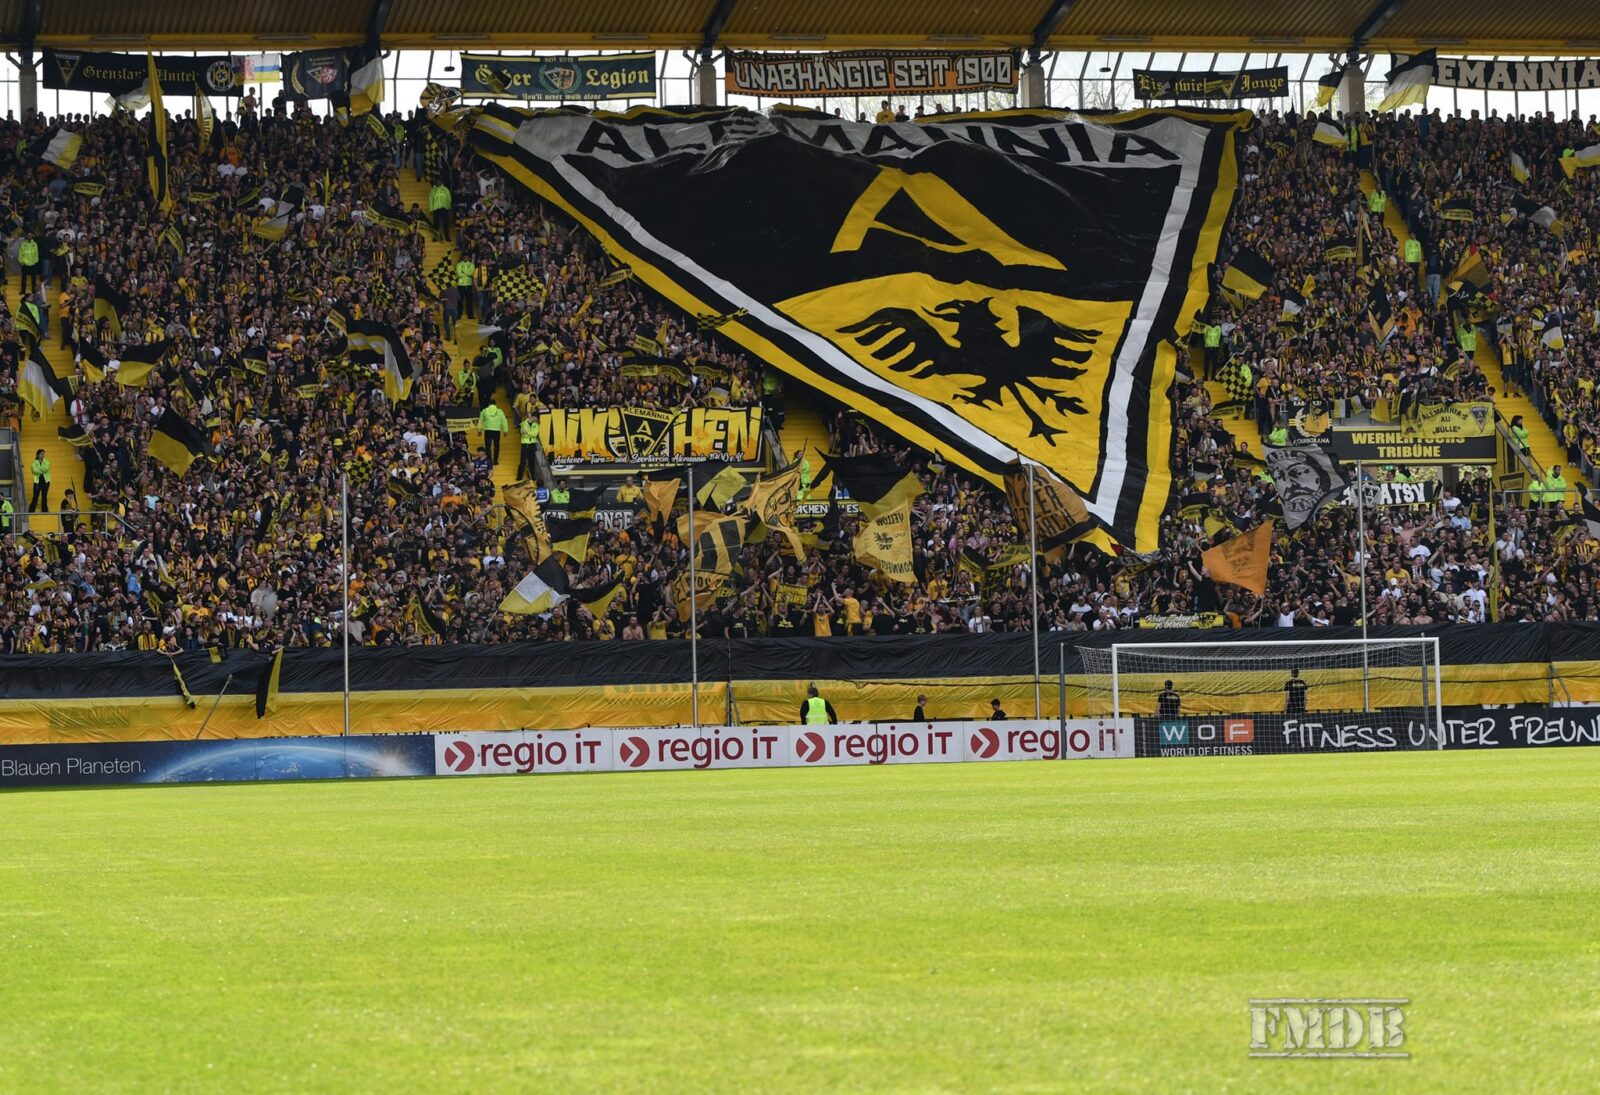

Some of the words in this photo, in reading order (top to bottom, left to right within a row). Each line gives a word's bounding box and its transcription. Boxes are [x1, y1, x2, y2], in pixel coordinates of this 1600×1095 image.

[586, 68, 650, 89] Legion
[735, 57, 888, 90] UNABHÄNGIG
[893, 59, 949, 87] SEIT
[955, 57, 1011, 85] 1900
[1396, 55, 1600, 89] EMANNIA
[623, 407, 671, 421] ALEMANNIA
[1377, 444, 1441, 458] TRIBÜNE
[834, 725, 919, 765] regio
[1007, 721, 1091, 760] rego
[1282, 719, 1397, 748] FITNESS
[1408, 717, 1499, 746] UNTER
[1509, 715, 1600, 745] FREUN
[481, 734, 567, 774] regio
[658, 729, 744, 769] regio
[1161, 748, 1195, 757] WORLD
[1198, 747, 1211, 756] OF
[1213, 746, 1253, 756] FITNESS
[1, 759, 61, 777] Blauen
[67, 757, 147, 775] Planeten.
